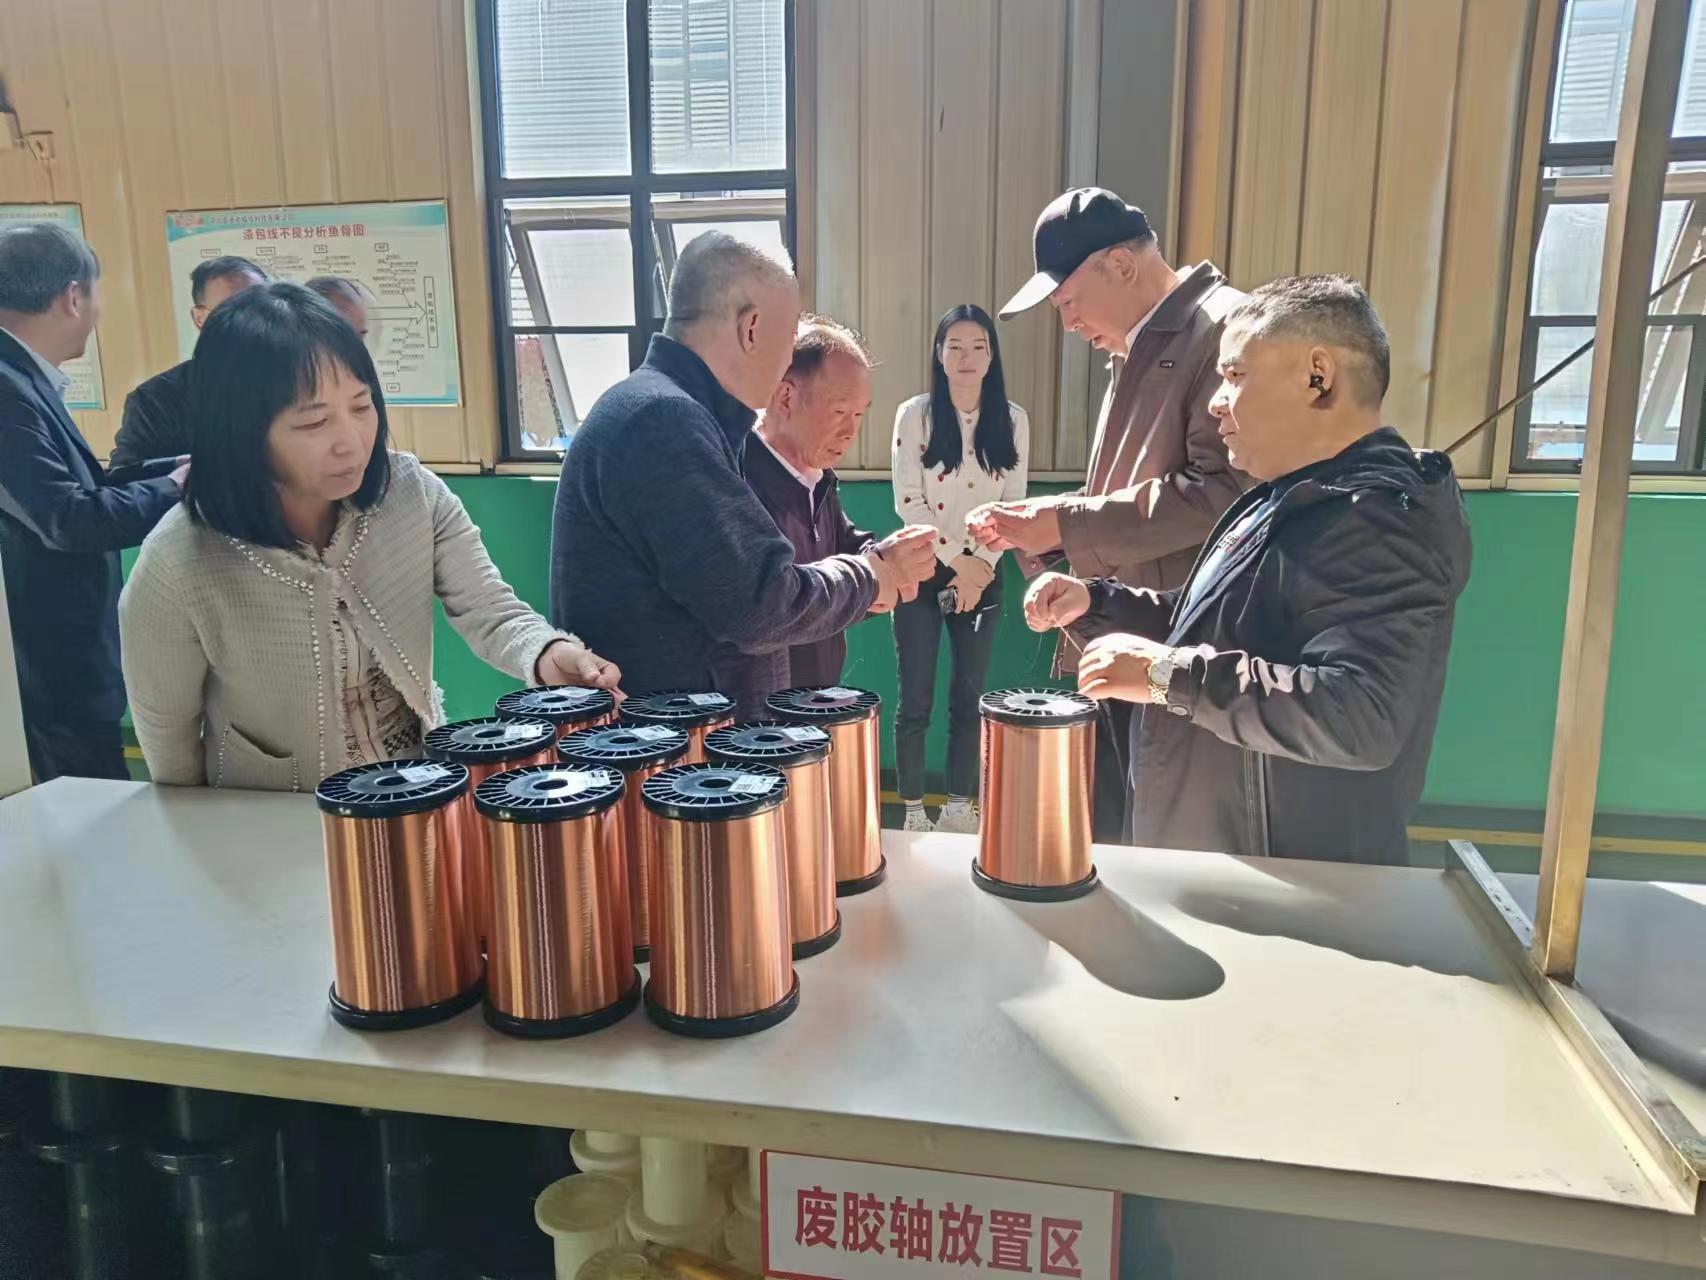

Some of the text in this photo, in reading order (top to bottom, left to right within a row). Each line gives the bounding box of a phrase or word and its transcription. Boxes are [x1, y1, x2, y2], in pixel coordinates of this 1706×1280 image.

[243, 224, 366, 240] 漆包线不良分析鱼骨图
[795, 1186, 1082, 1277] 废胶轴放置区
